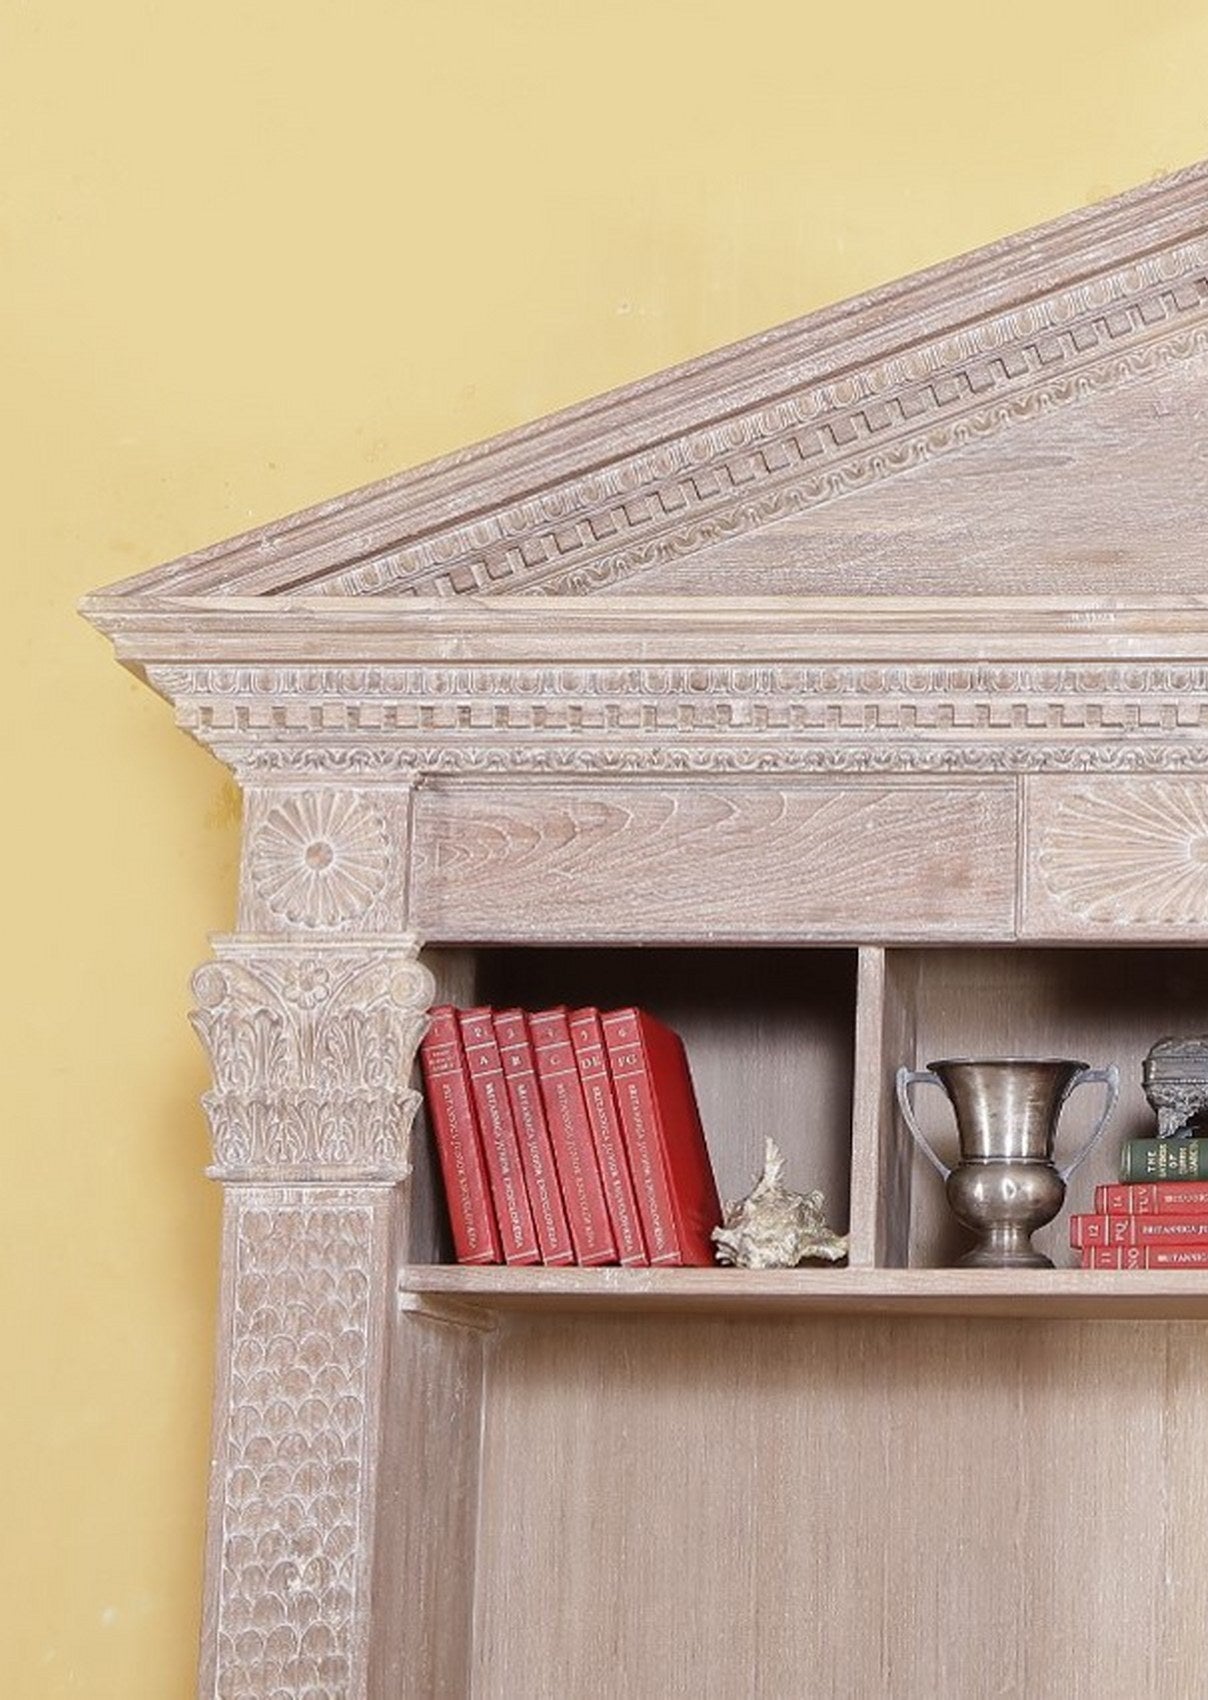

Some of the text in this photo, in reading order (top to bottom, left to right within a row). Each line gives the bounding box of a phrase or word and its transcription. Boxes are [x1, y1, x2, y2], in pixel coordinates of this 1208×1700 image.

[474, 1027, 483, 1038] 2
[479, 1056, 489, 1065] A
[511, 1056, 522, 1066] B
[581, 1055, 602, 1069] DE
[617, 1053, 638, 1067] FG
[1148, 1151, 1156, 1172] THE
[1169, 1154, 1178, 1169] OF
[1139, 1186, 1149, 1214] TUV
[1088, 1225, 1098, 1237] 12
[1115, 1220, 1128, 1241] PQ
[1101, 1252, 1111, 1263] 11
[1128, 1248, 1139, 1269] NO
